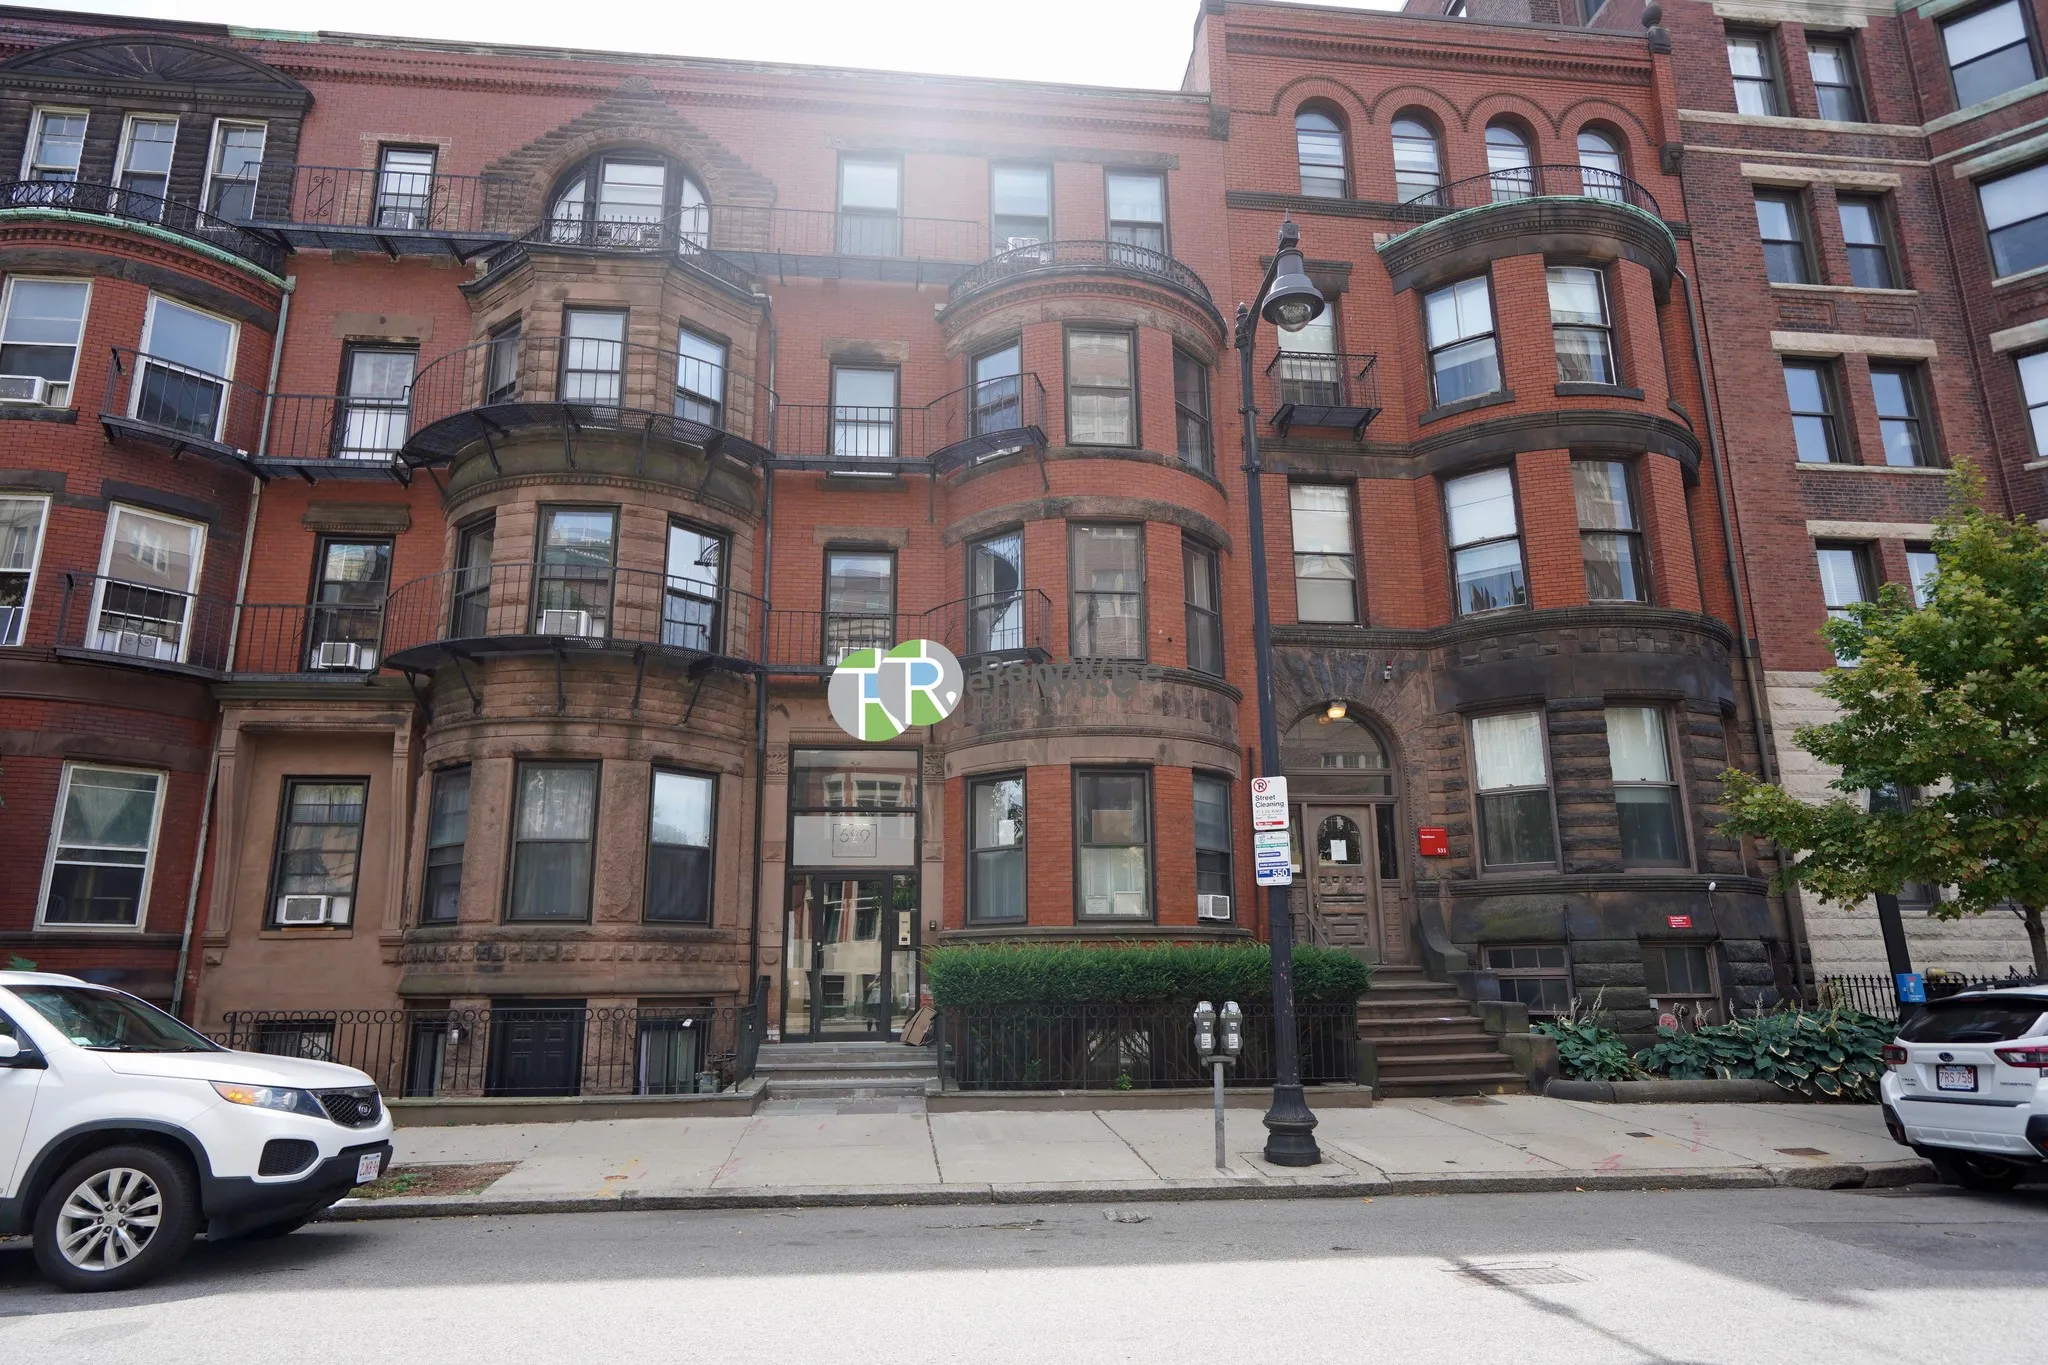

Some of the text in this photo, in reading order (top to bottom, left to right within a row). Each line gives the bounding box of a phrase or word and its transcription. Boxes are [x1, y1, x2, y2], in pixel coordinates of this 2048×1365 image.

[1272, 868, 1288, 877] 550
[1939, 1071, 1972, 1084] 7RS 758
